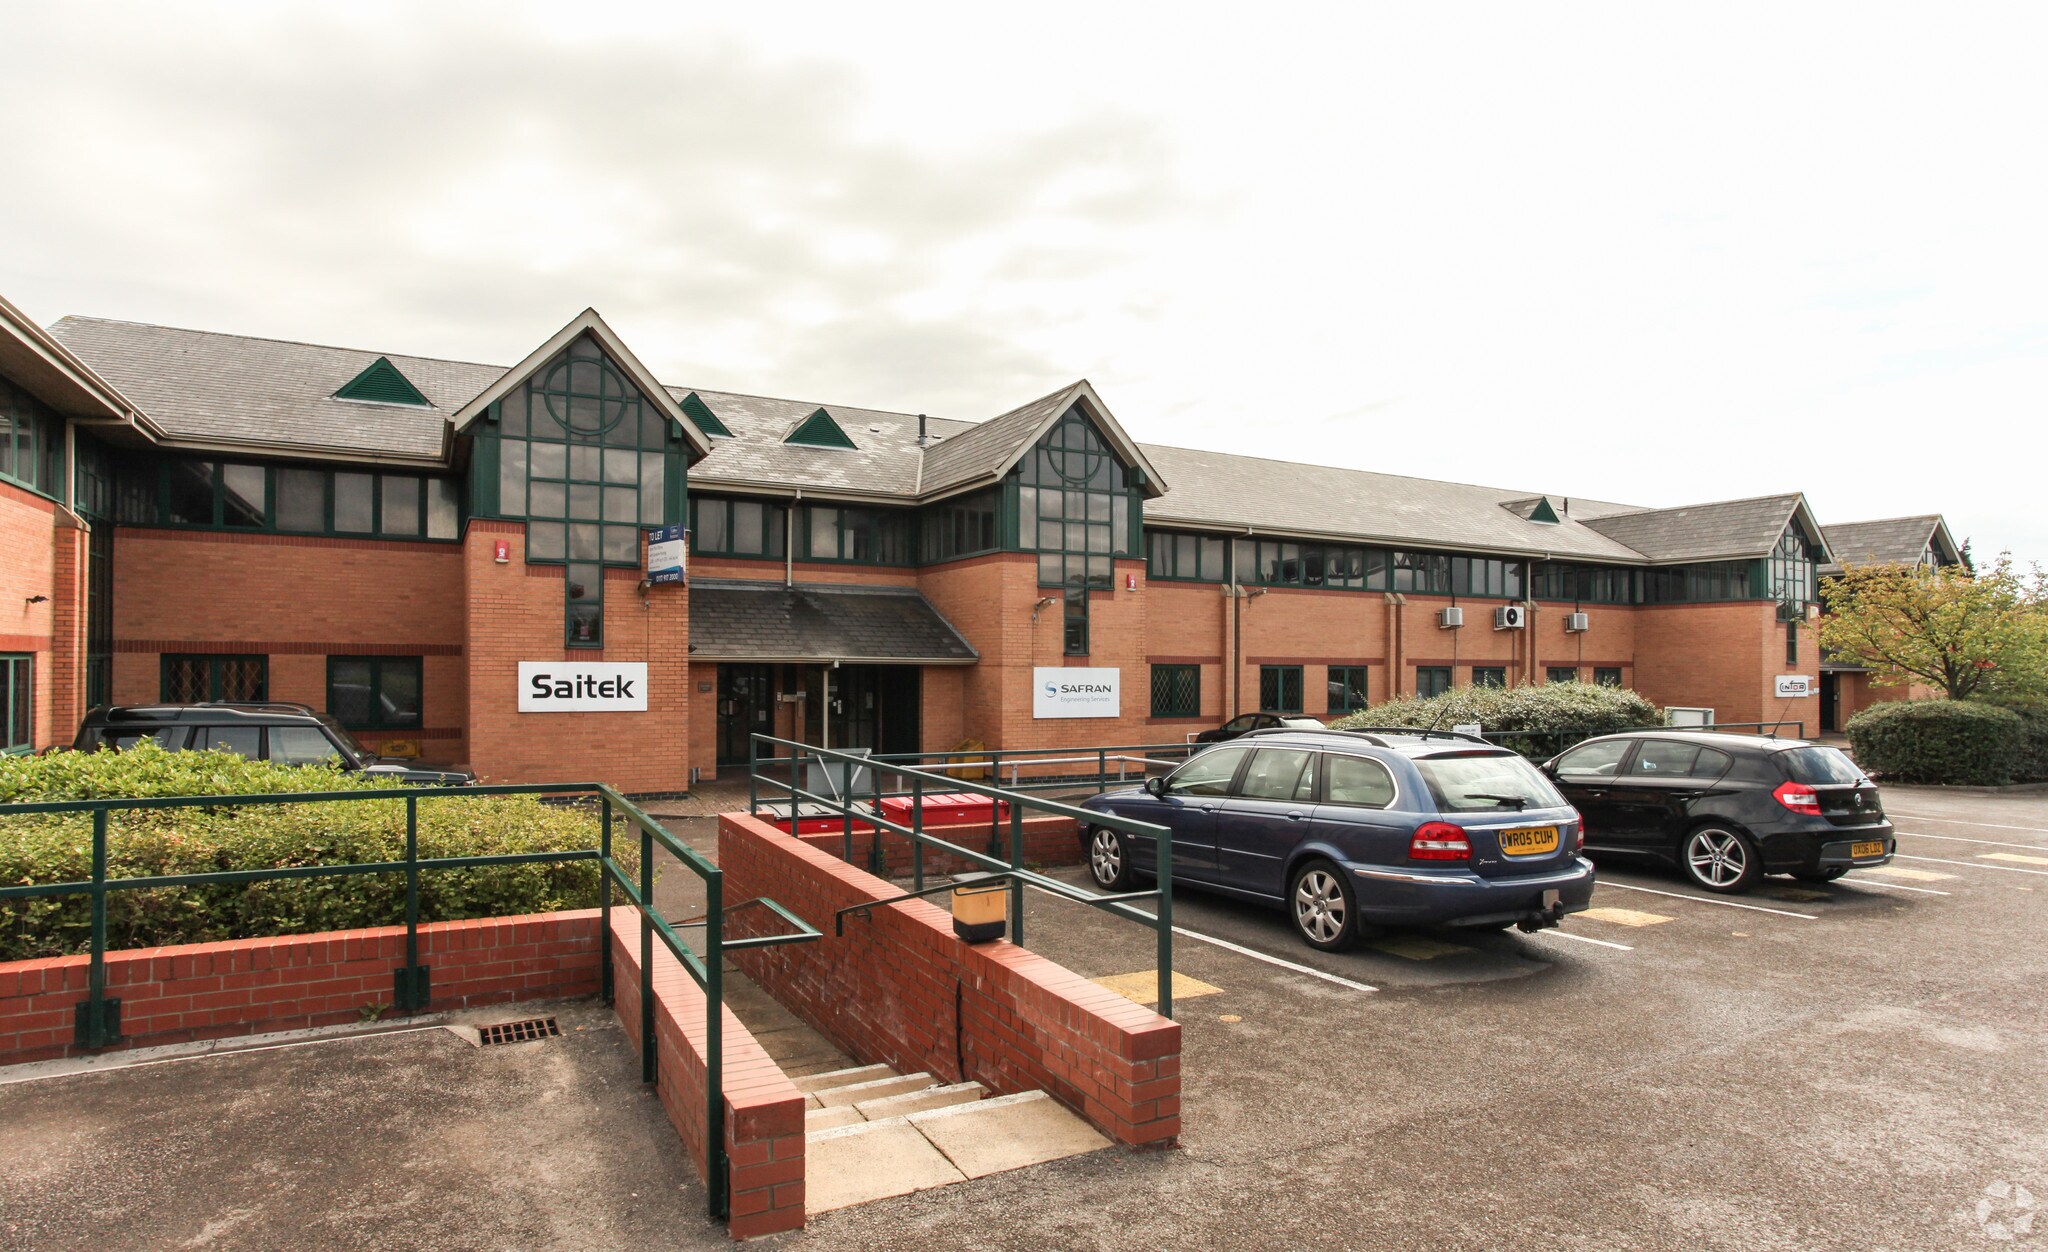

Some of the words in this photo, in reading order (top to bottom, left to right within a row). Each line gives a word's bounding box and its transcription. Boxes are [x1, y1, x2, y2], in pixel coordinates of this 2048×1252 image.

[649, 532, 654, 541] TO
[655, 530, 663, 540] LET
[531, 674, 635, 699] Saitek
[1060, 684, 1112, 693] SAFRAN
[1506, 831, 1532, 847] WR05
[1534, 830, 1554, 844] CUH
